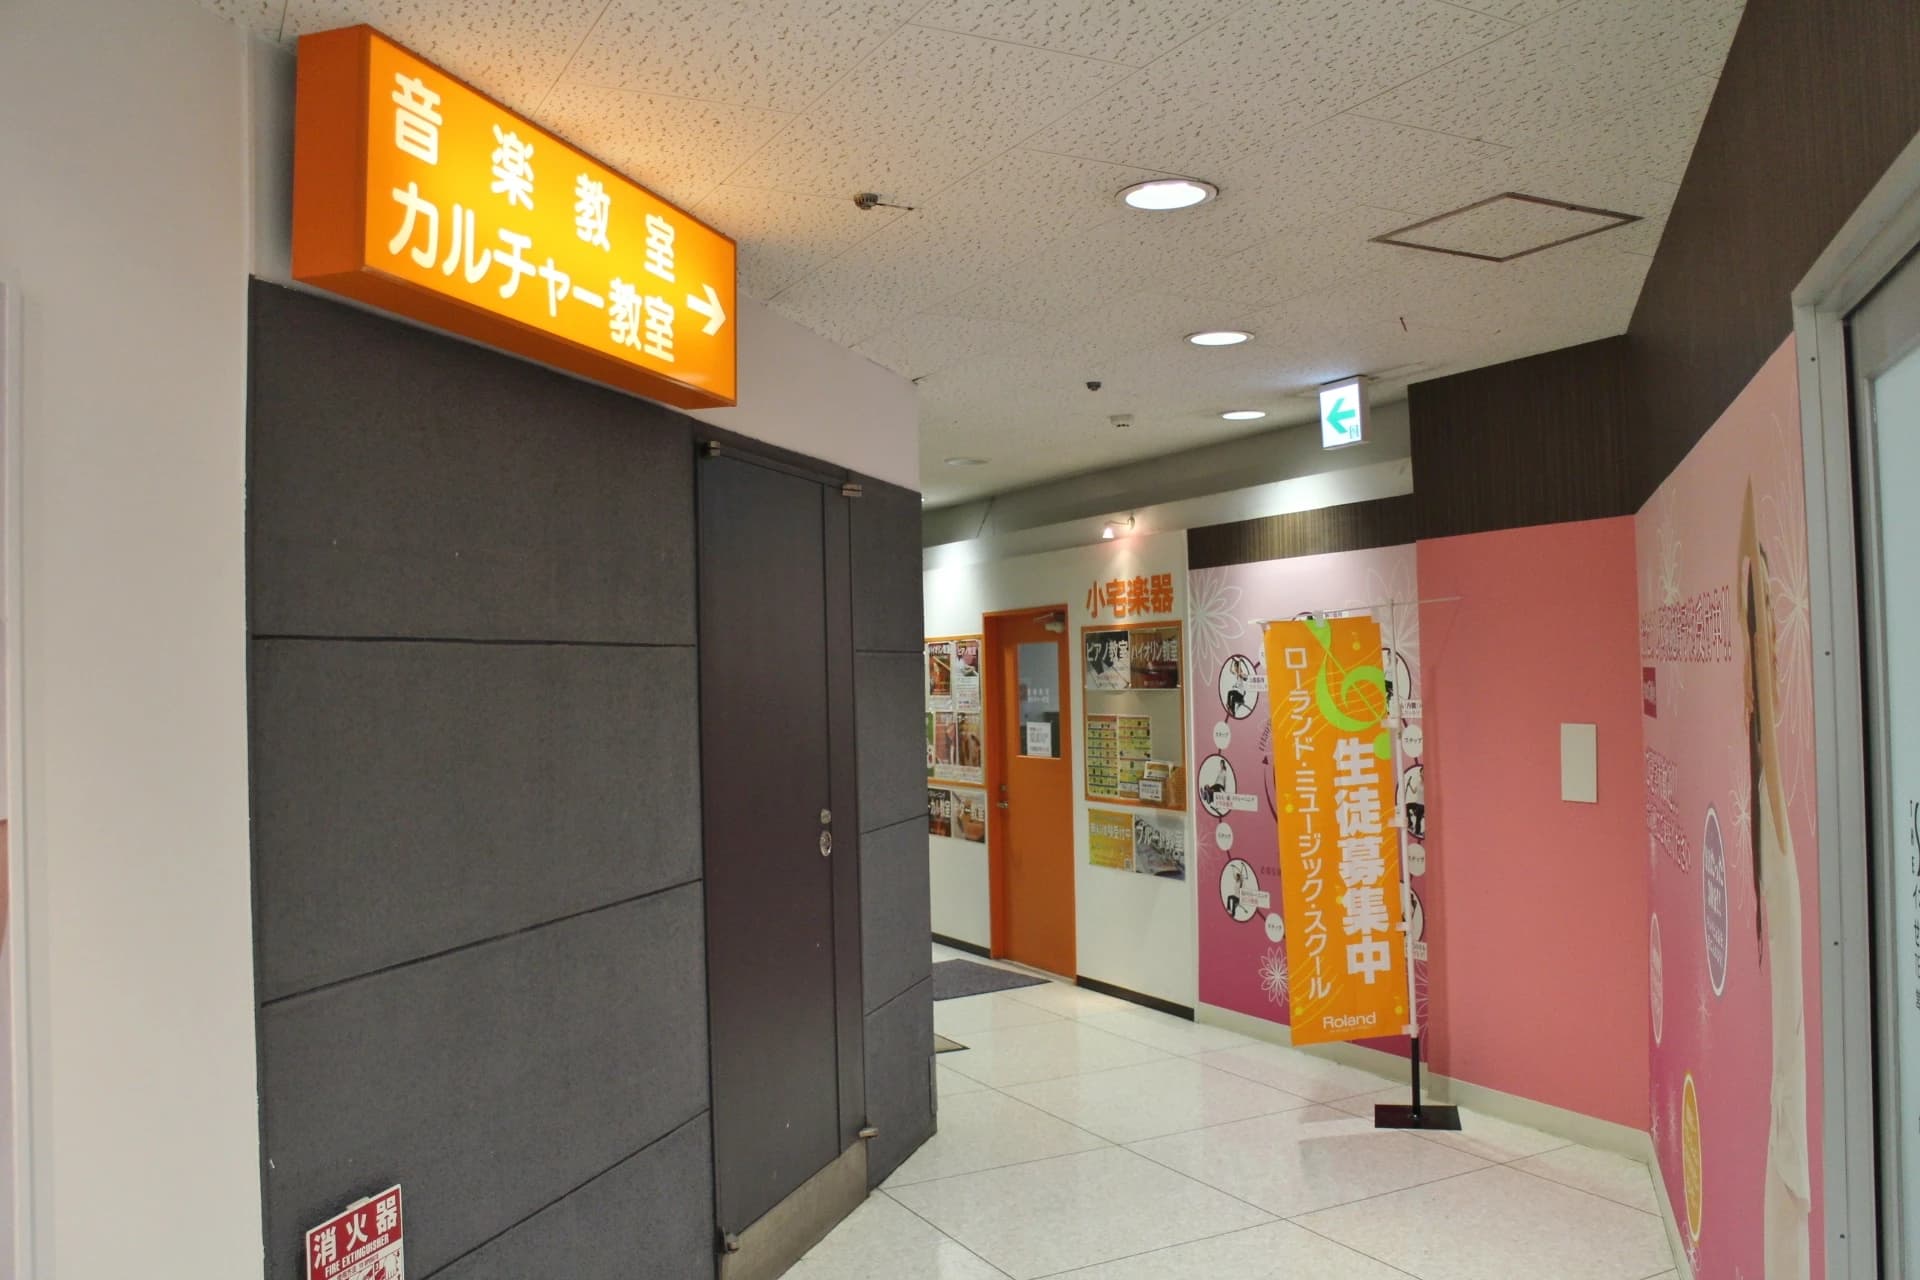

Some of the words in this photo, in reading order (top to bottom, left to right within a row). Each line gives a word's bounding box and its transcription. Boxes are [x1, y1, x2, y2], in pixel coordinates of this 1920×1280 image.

[391, 71, 676, 283] 音楽教室
[388, 181, 676, 363] カルチャー教室
[1086, 572, 1174, 619] 小宅楽器
[1086, 639, 1129, 663] ピアノ教室
[1333, 736, 1392, 985] 生徒募集中
[1322, 1010, 1377, 1030] Roland
[313, 1194, 397, 1269] 消火器
[325, 1260, 341, 1279] FIRE
[342, 1233, 390, 1269] EXTINGUISHER
